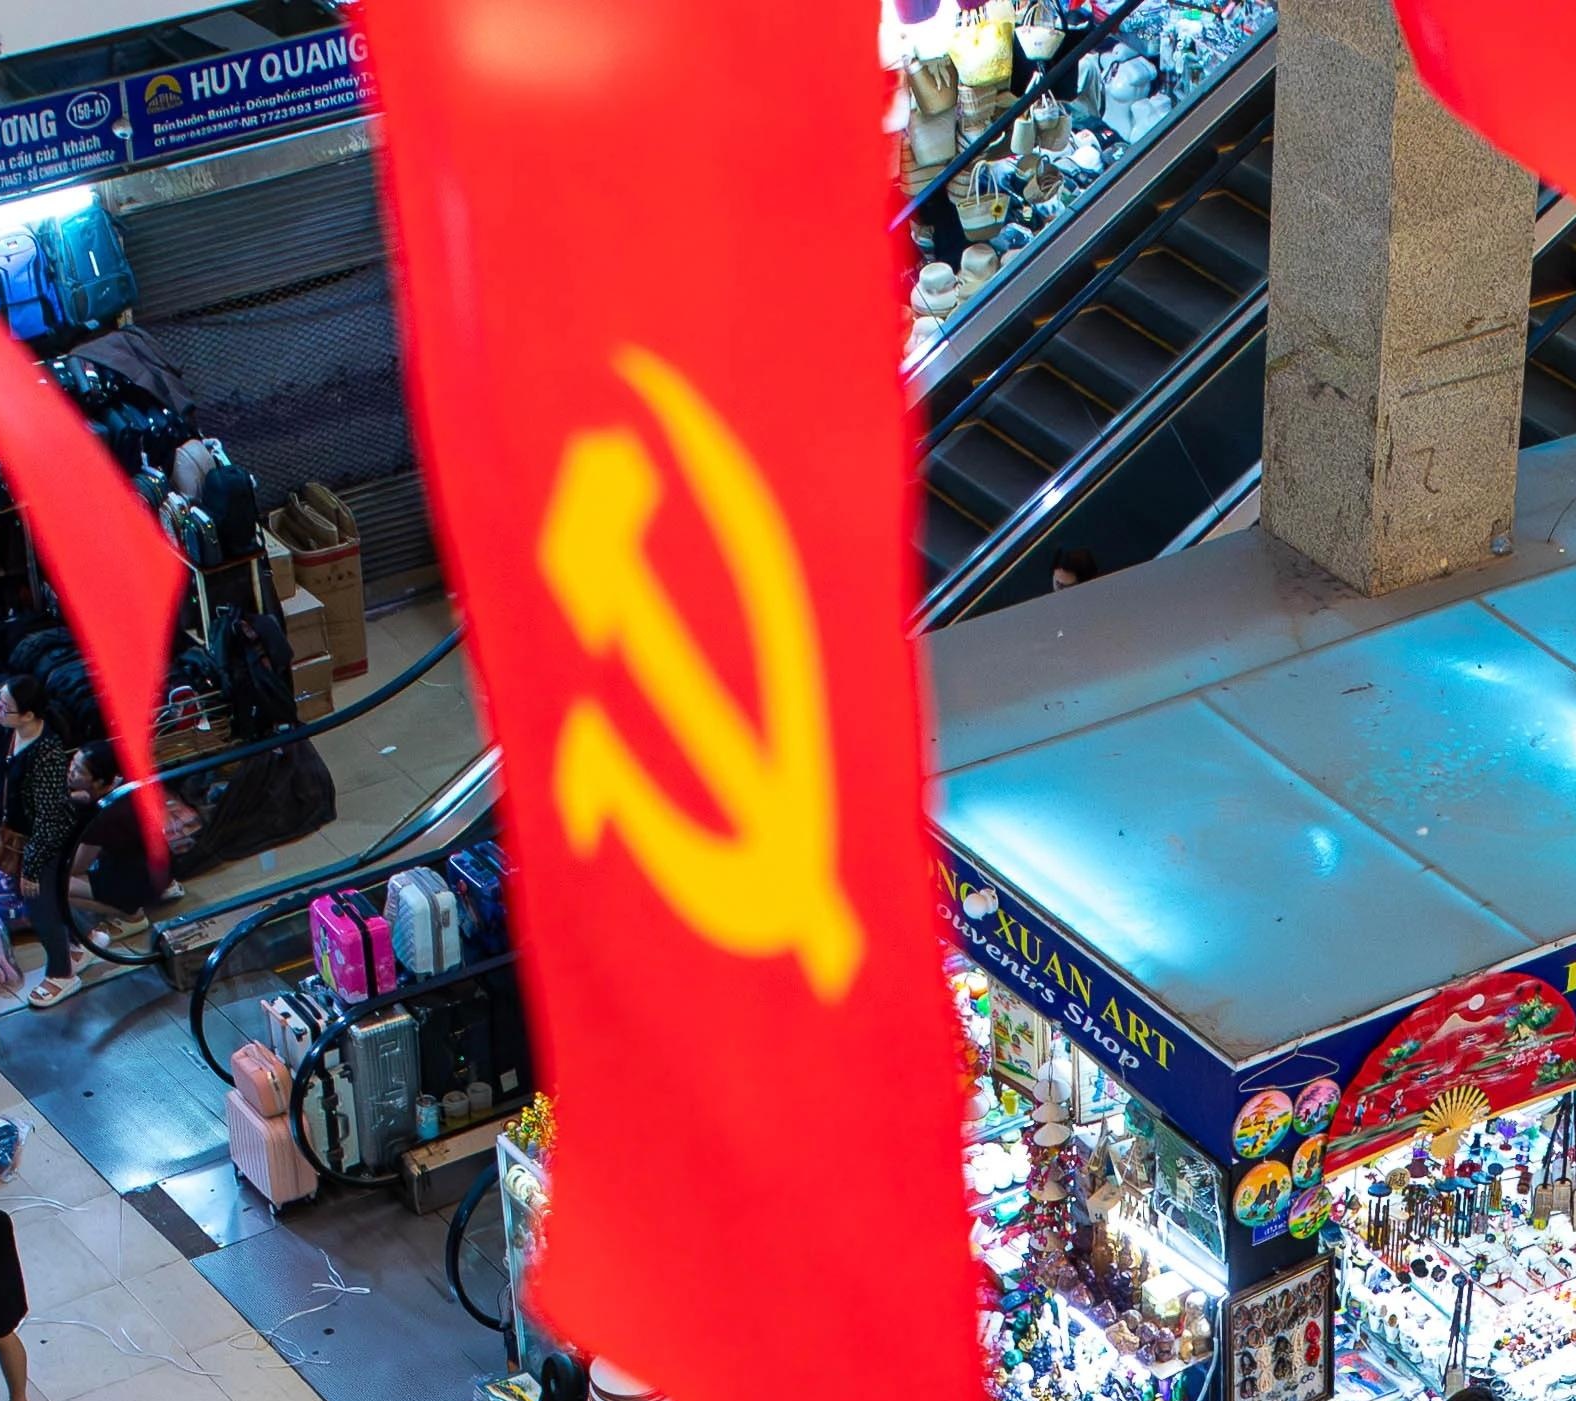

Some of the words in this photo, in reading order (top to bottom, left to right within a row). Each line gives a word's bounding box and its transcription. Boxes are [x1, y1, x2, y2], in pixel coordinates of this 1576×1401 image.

[190, 58, 252, 101] HUY
[260, 32, 369, 84] QUANG
[62, 135, 100, 158] khách
[936, 904, 1056, 1004] ouvenirs
[1064, 1002, 1140, 1078] Shop
[993, 908, 1093, 1009] XUAN
[1100, 997, 1176, 1072] ART
